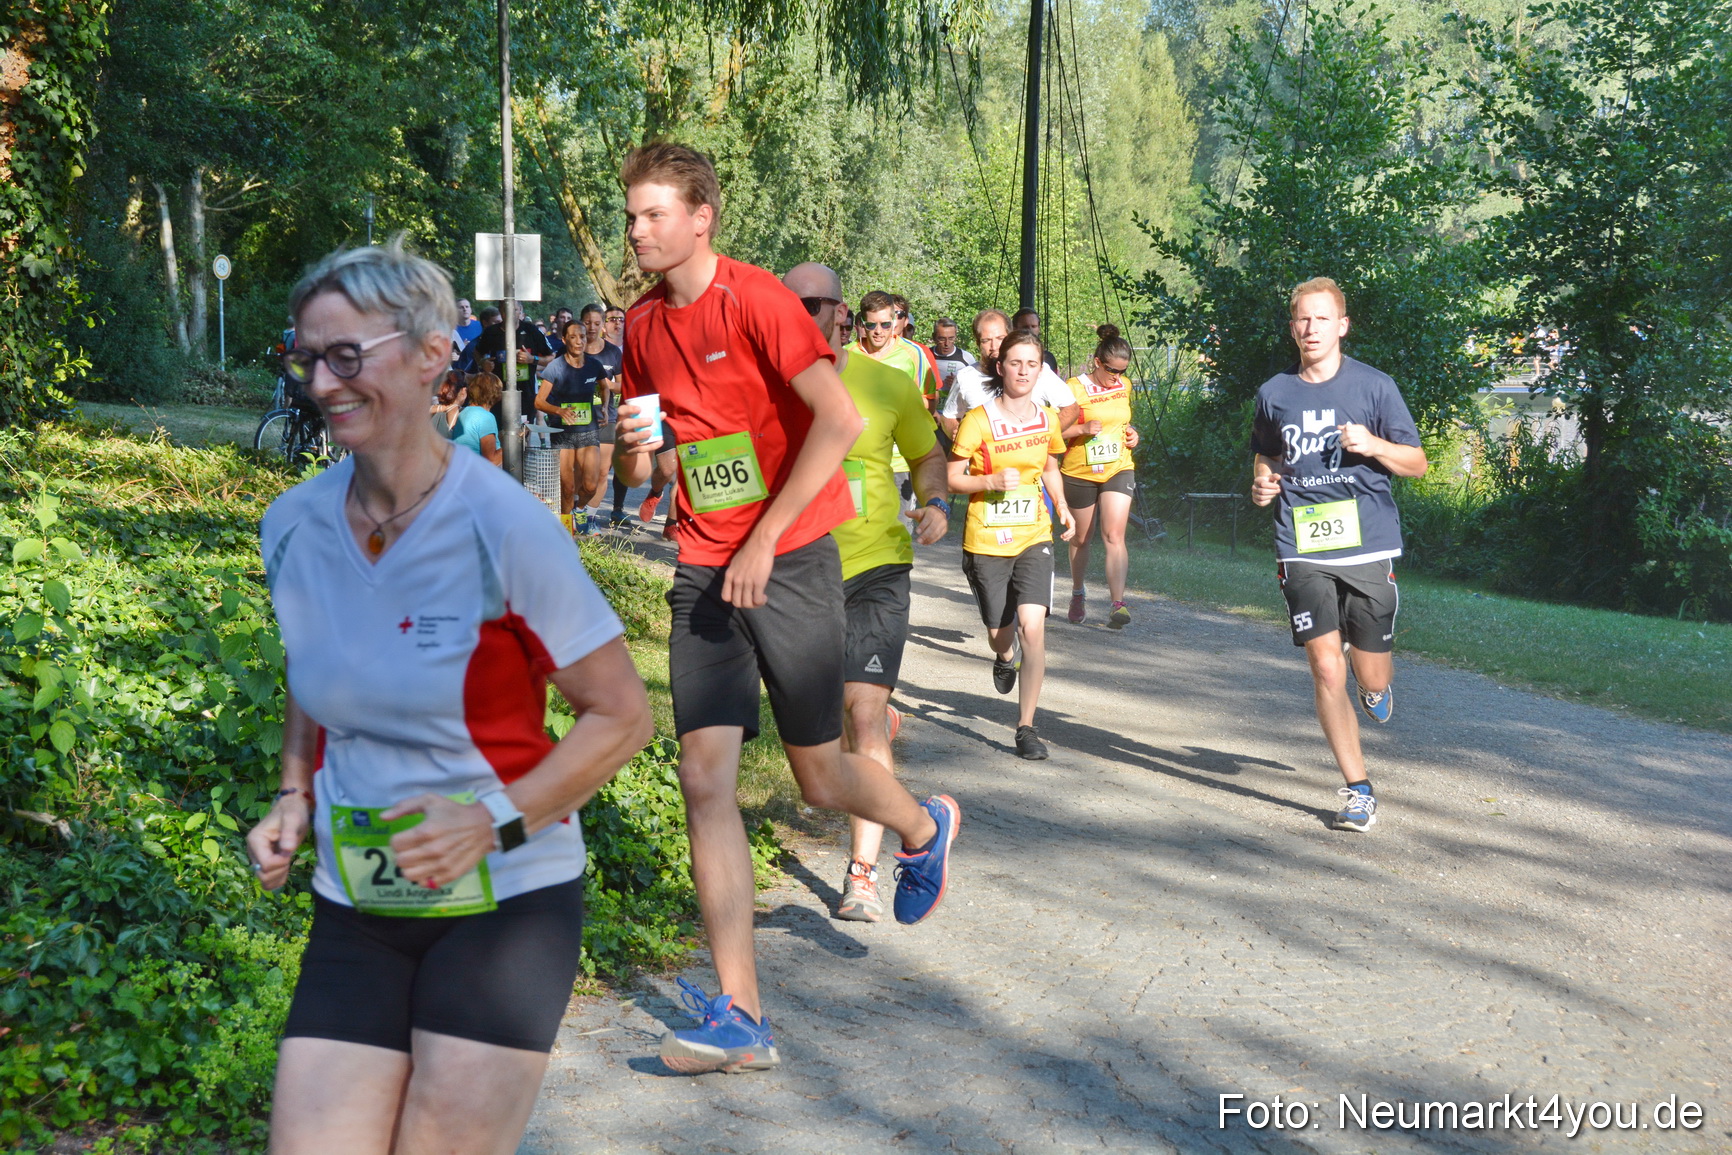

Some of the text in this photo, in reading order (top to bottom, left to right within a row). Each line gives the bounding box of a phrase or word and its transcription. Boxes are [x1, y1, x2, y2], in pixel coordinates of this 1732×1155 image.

[994, 435, 1048, 454] MAX BÖGL
[1090, 443, 1118, 456] 1218
[691, 459, 749, 492] 1496
[990, 499, 1031, 515] 1217
[1309, 519, 1345, 538] 293
[1292, 610, 1313, 633] 55
